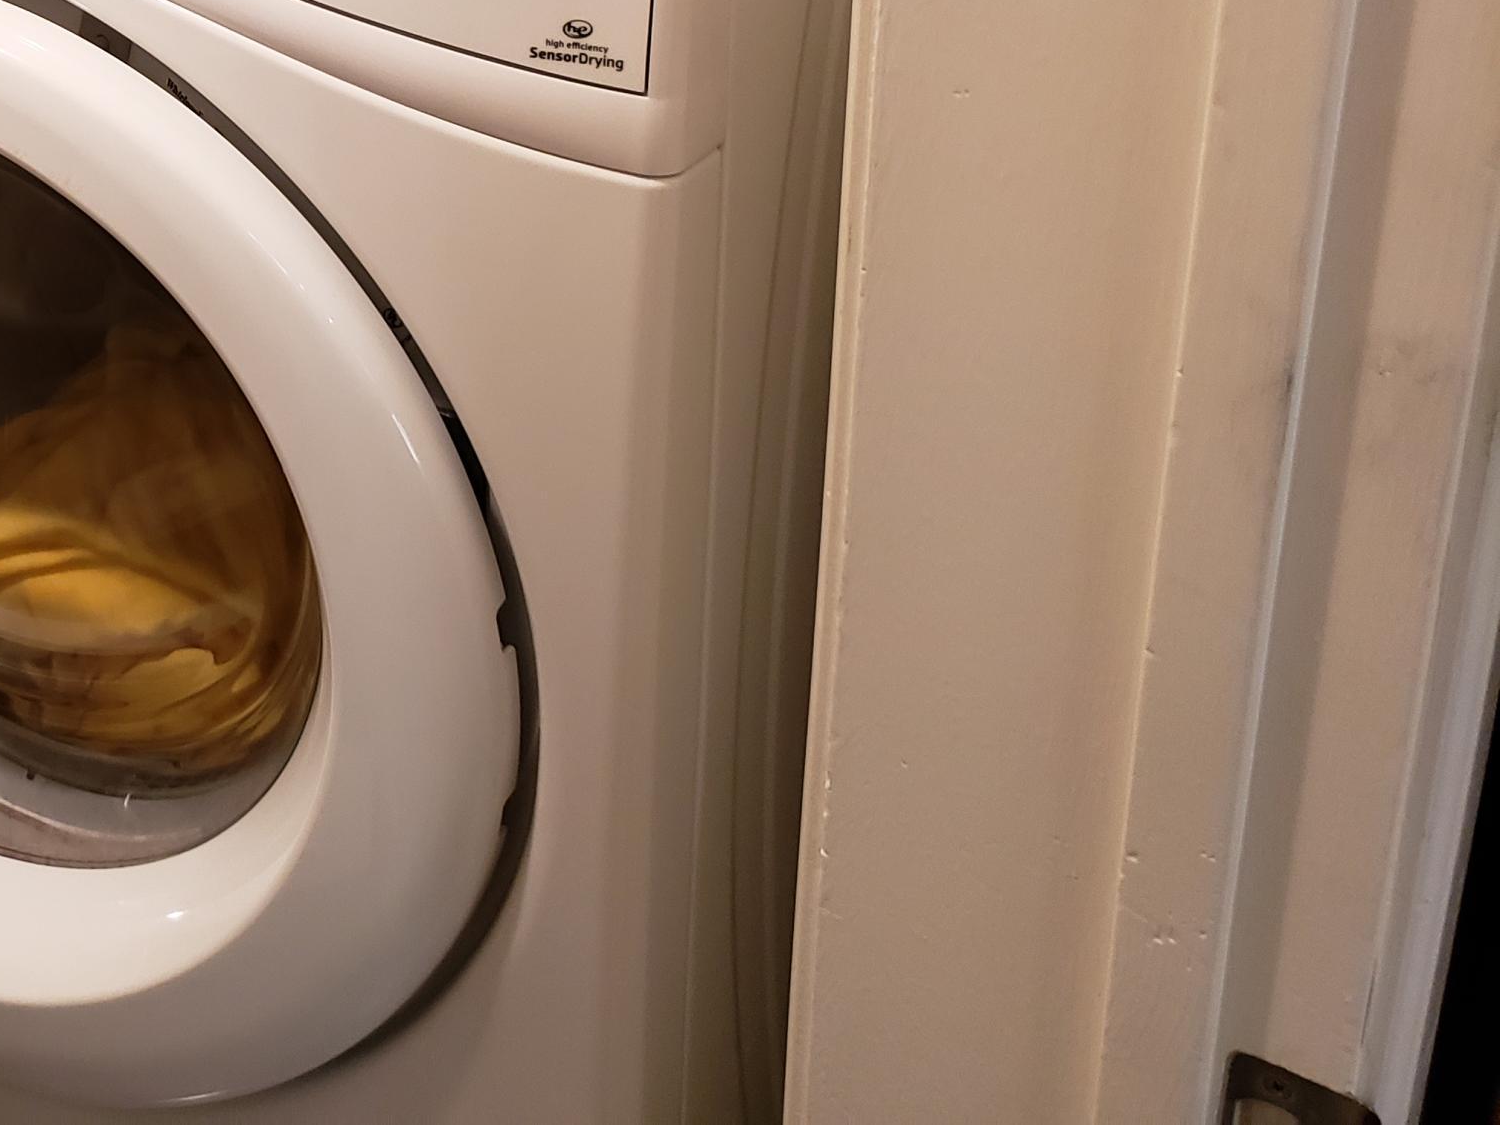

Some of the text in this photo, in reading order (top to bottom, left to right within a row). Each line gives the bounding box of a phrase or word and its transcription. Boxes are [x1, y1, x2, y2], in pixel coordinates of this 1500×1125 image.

[545, 37, 609, 54] high efficiency
[529, 46, 625, 72] SensorDrying
